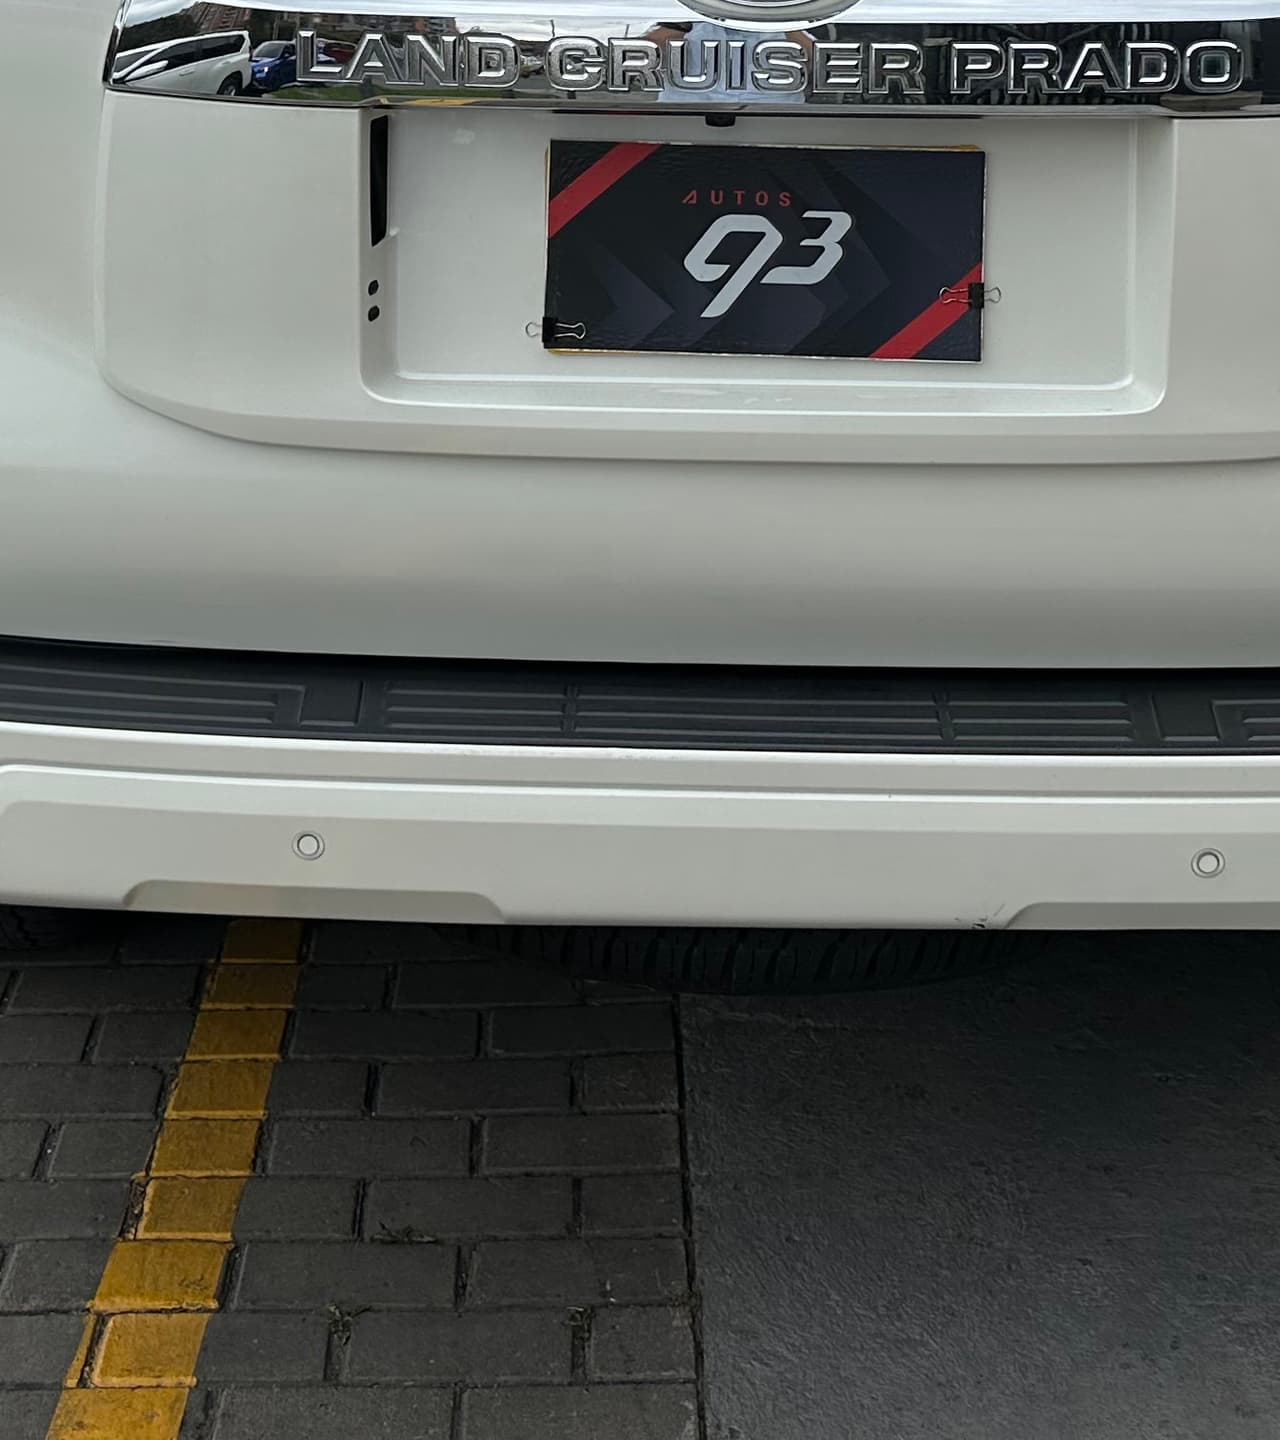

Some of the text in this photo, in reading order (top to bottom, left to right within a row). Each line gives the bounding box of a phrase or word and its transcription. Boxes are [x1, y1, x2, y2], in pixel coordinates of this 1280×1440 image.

[297, 30, 1244, 95] LAND CRUISER PRADO
[682, 189, 792, 208] AUTOS
[683, 210, 853, 319] 93
